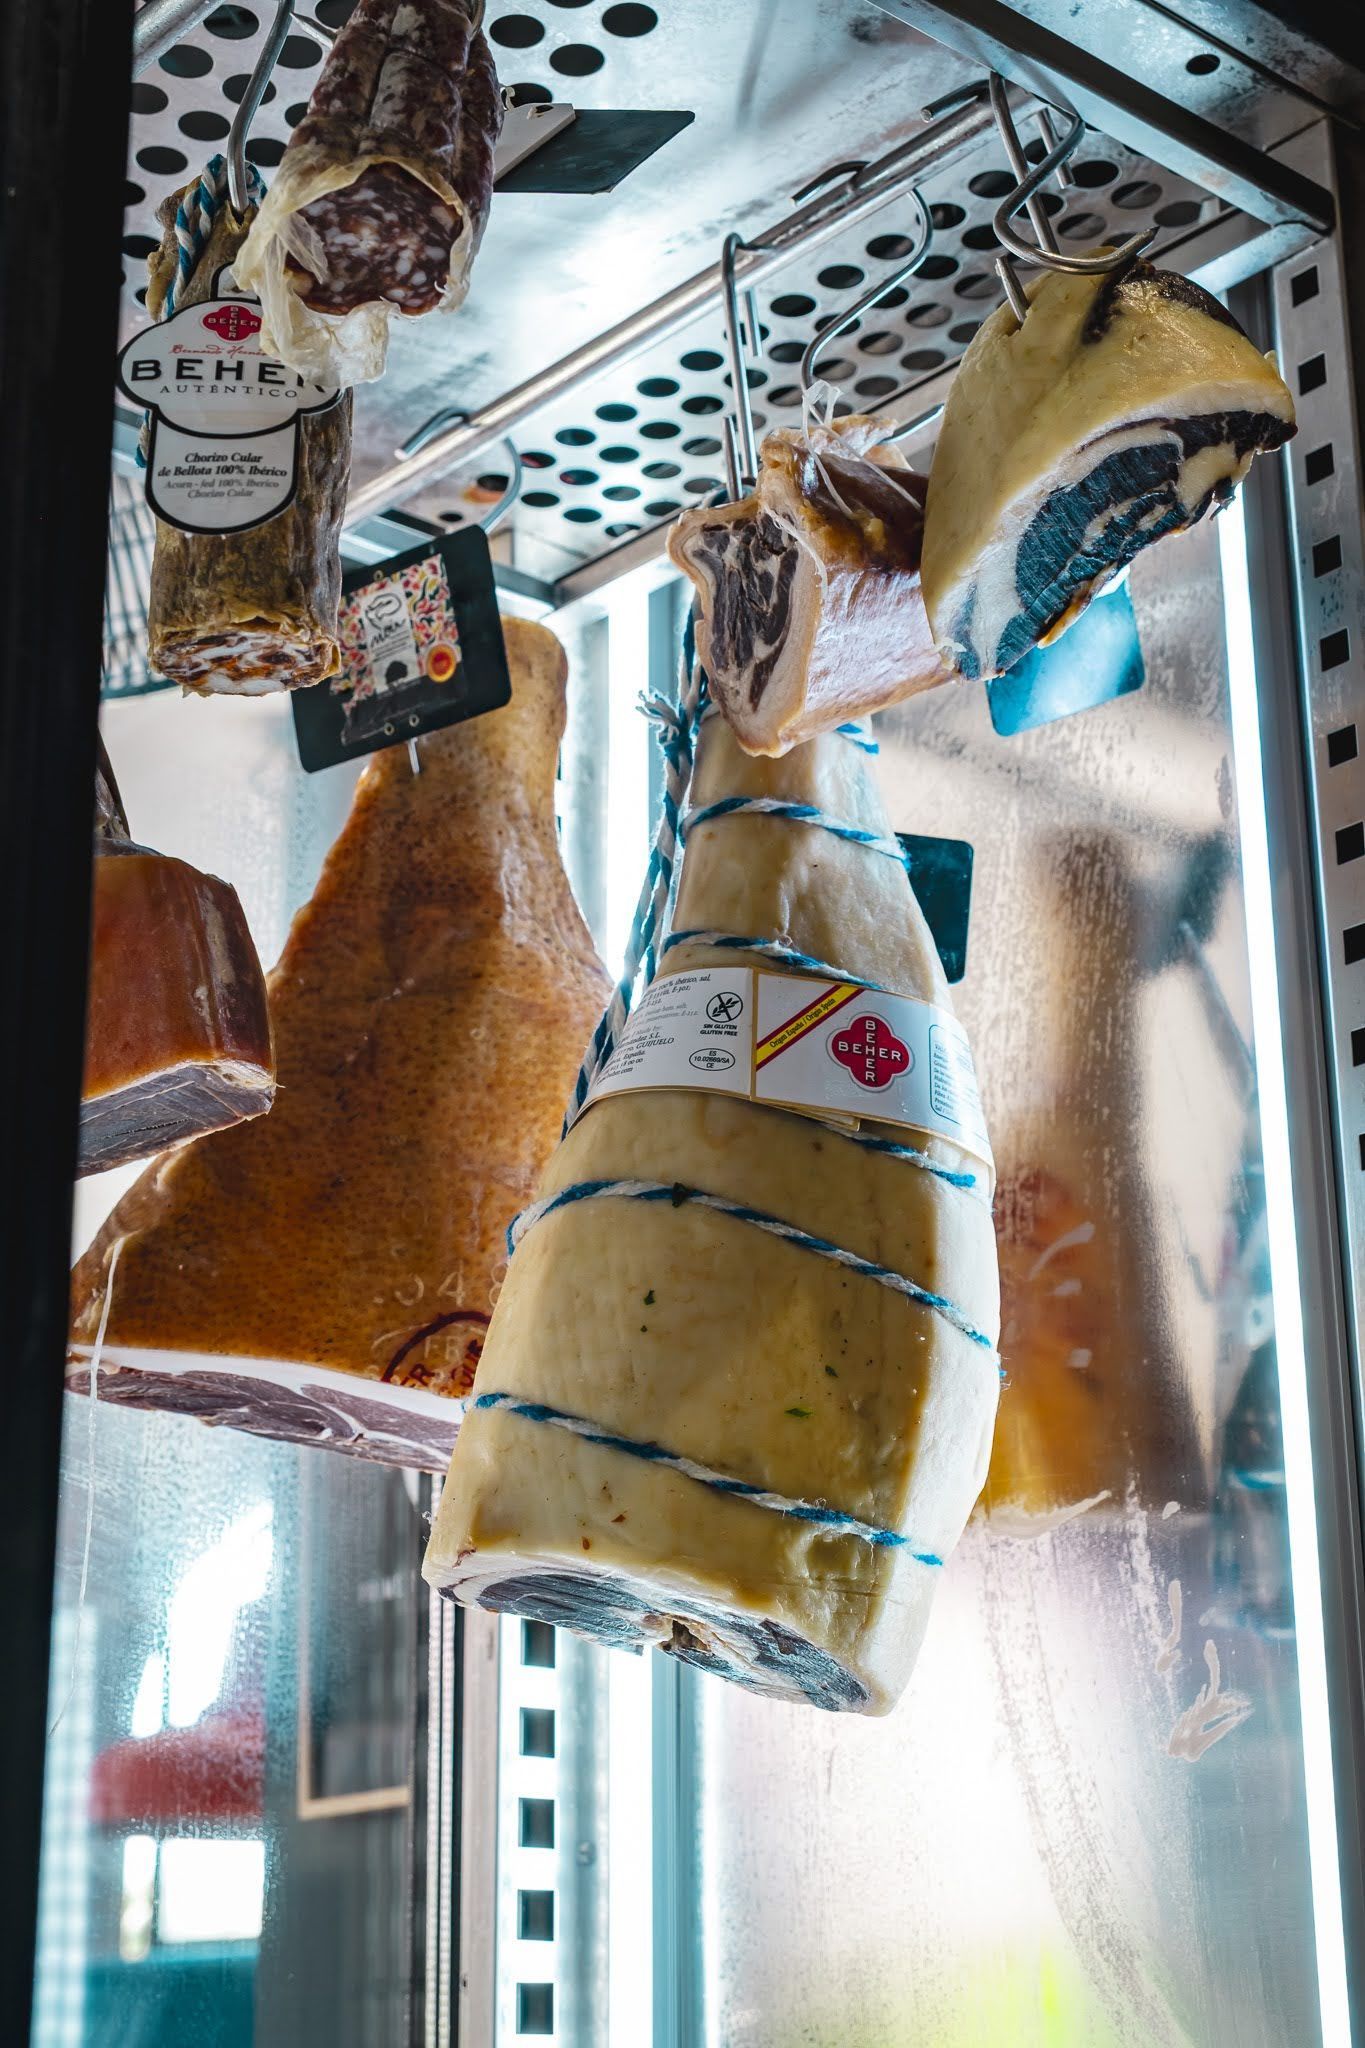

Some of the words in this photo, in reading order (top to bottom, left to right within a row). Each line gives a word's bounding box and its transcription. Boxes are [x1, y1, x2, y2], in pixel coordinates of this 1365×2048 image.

[208, 317, 259, 328] BEHER
[184, 452, 229, 463] Chorizo
[230, 452, 264, 463] Cular
[158, 466, 171, 477] de
[173, 464, 212, 476] Bellota
[215, 465, 246, 475] 100%
[248, 465, 288, 477] Ibérico
[838, 1041, 902, 1062] BEHER
[865, 1020, 877, 1082] BEHER
